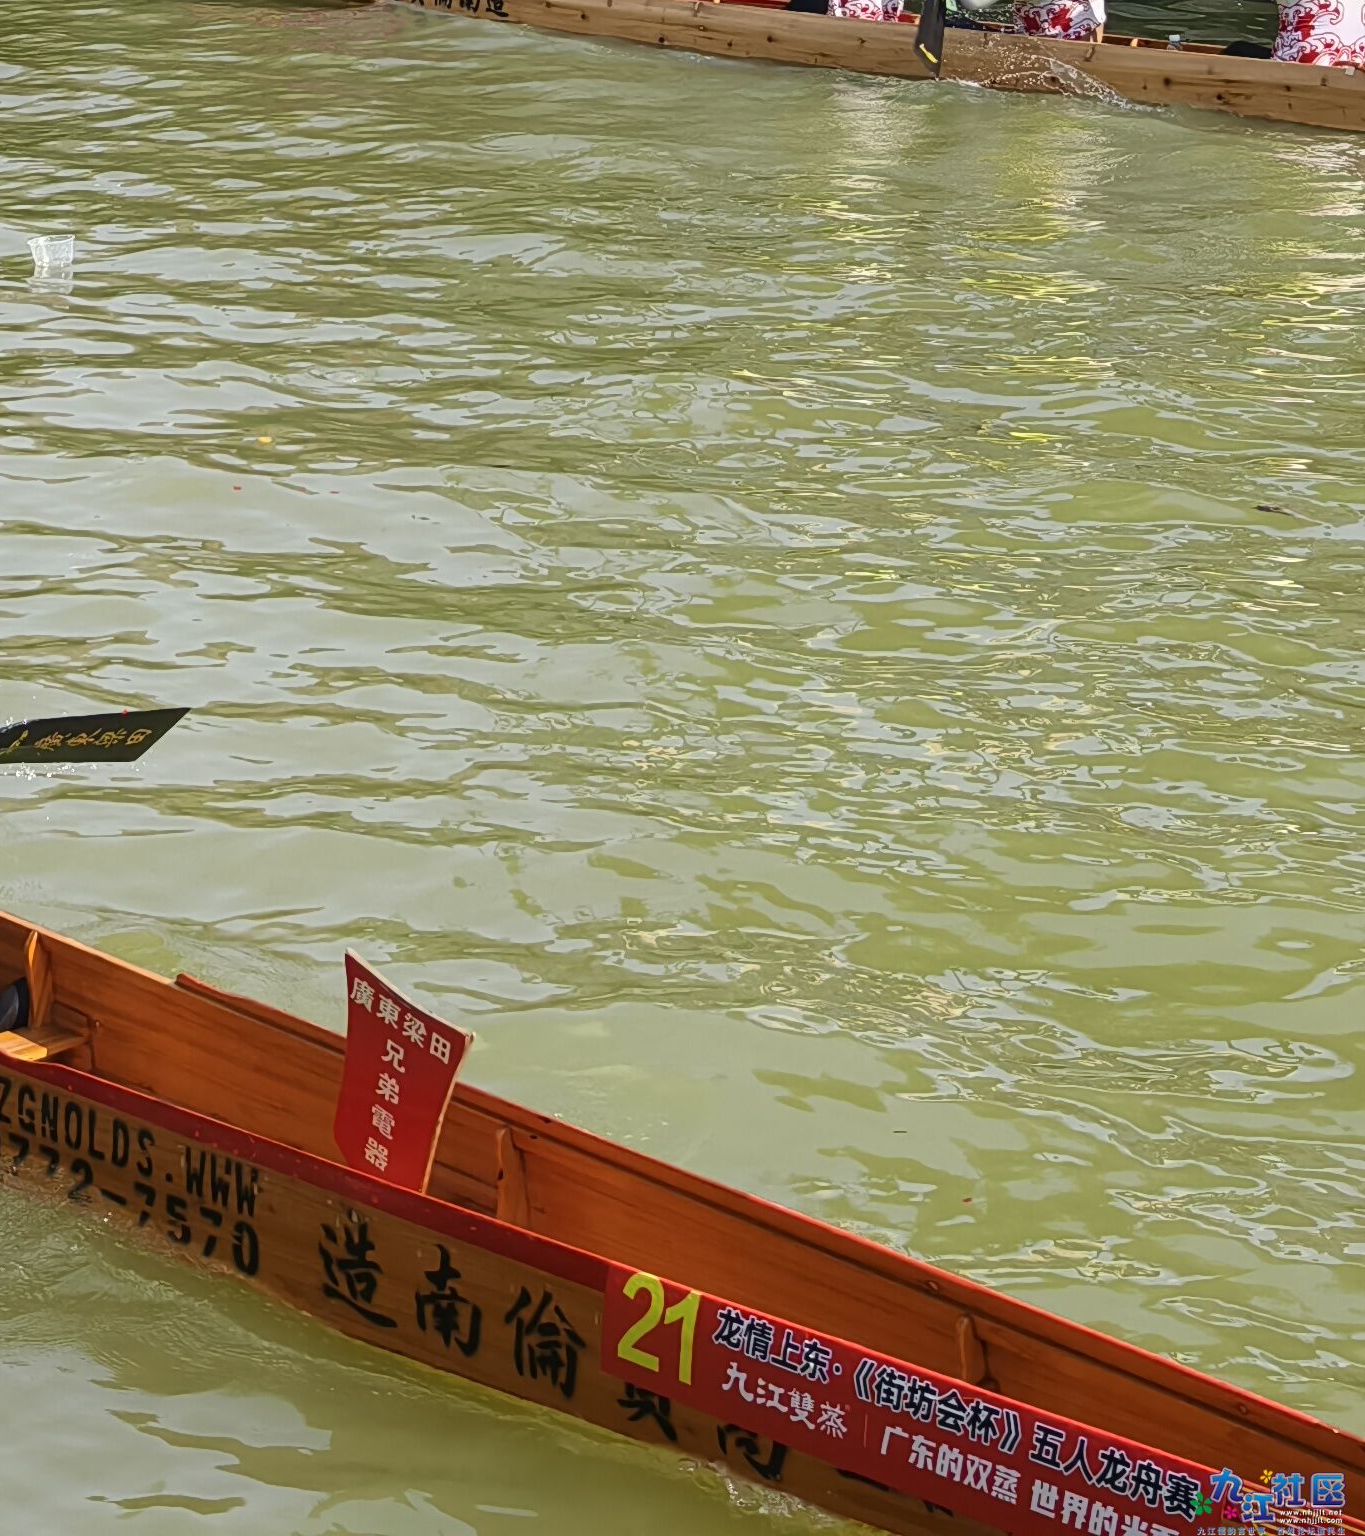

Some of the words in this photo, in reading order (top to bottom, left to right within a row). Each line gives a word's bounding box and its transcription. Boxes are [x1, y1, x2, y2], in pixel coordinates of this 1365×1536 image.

[617, 1270, 701, 1386] 21
[880, 1425, 1021, 1505] 广东的双蒸
